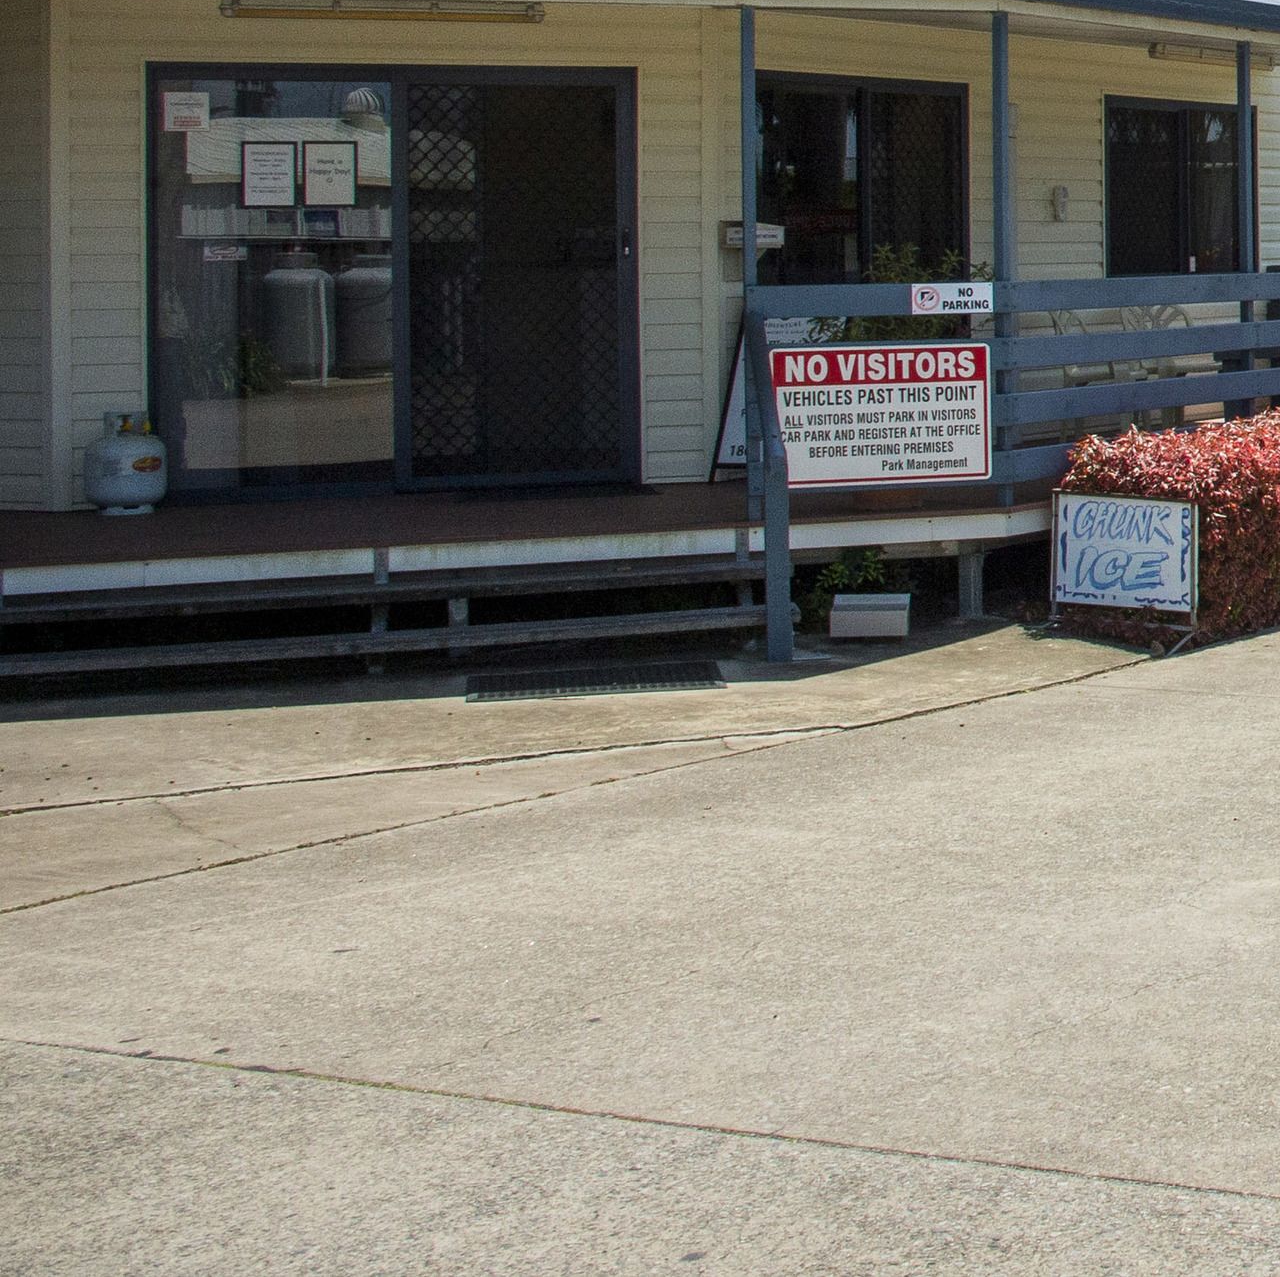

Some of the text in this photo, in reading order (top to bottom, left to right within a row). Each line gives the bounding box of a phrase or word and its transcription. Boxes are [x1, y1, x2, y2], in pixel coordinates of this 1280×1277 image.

[958, 287, 974, 298] NO
[943, 299, 989, 310] PARKING
[785, 350, 976, 383] NO VISITORS
[783, 385, 977, 407] VEHICLES PAST THIS POINT
[785, 409, 976, 428] ALL VISITORS MUST PARK IN VISITORS
[781, 424, 981, 442] CAR PARK AND REGISTER AT THE OFFICE
[809, 441, 954, 458] BEFORE ENTERING PREMISES
[881, 457, 968, 471] Park Management
[1072, 501, 1174, 546] CHUNK
[1075, 545, 1170, 592] ICE
